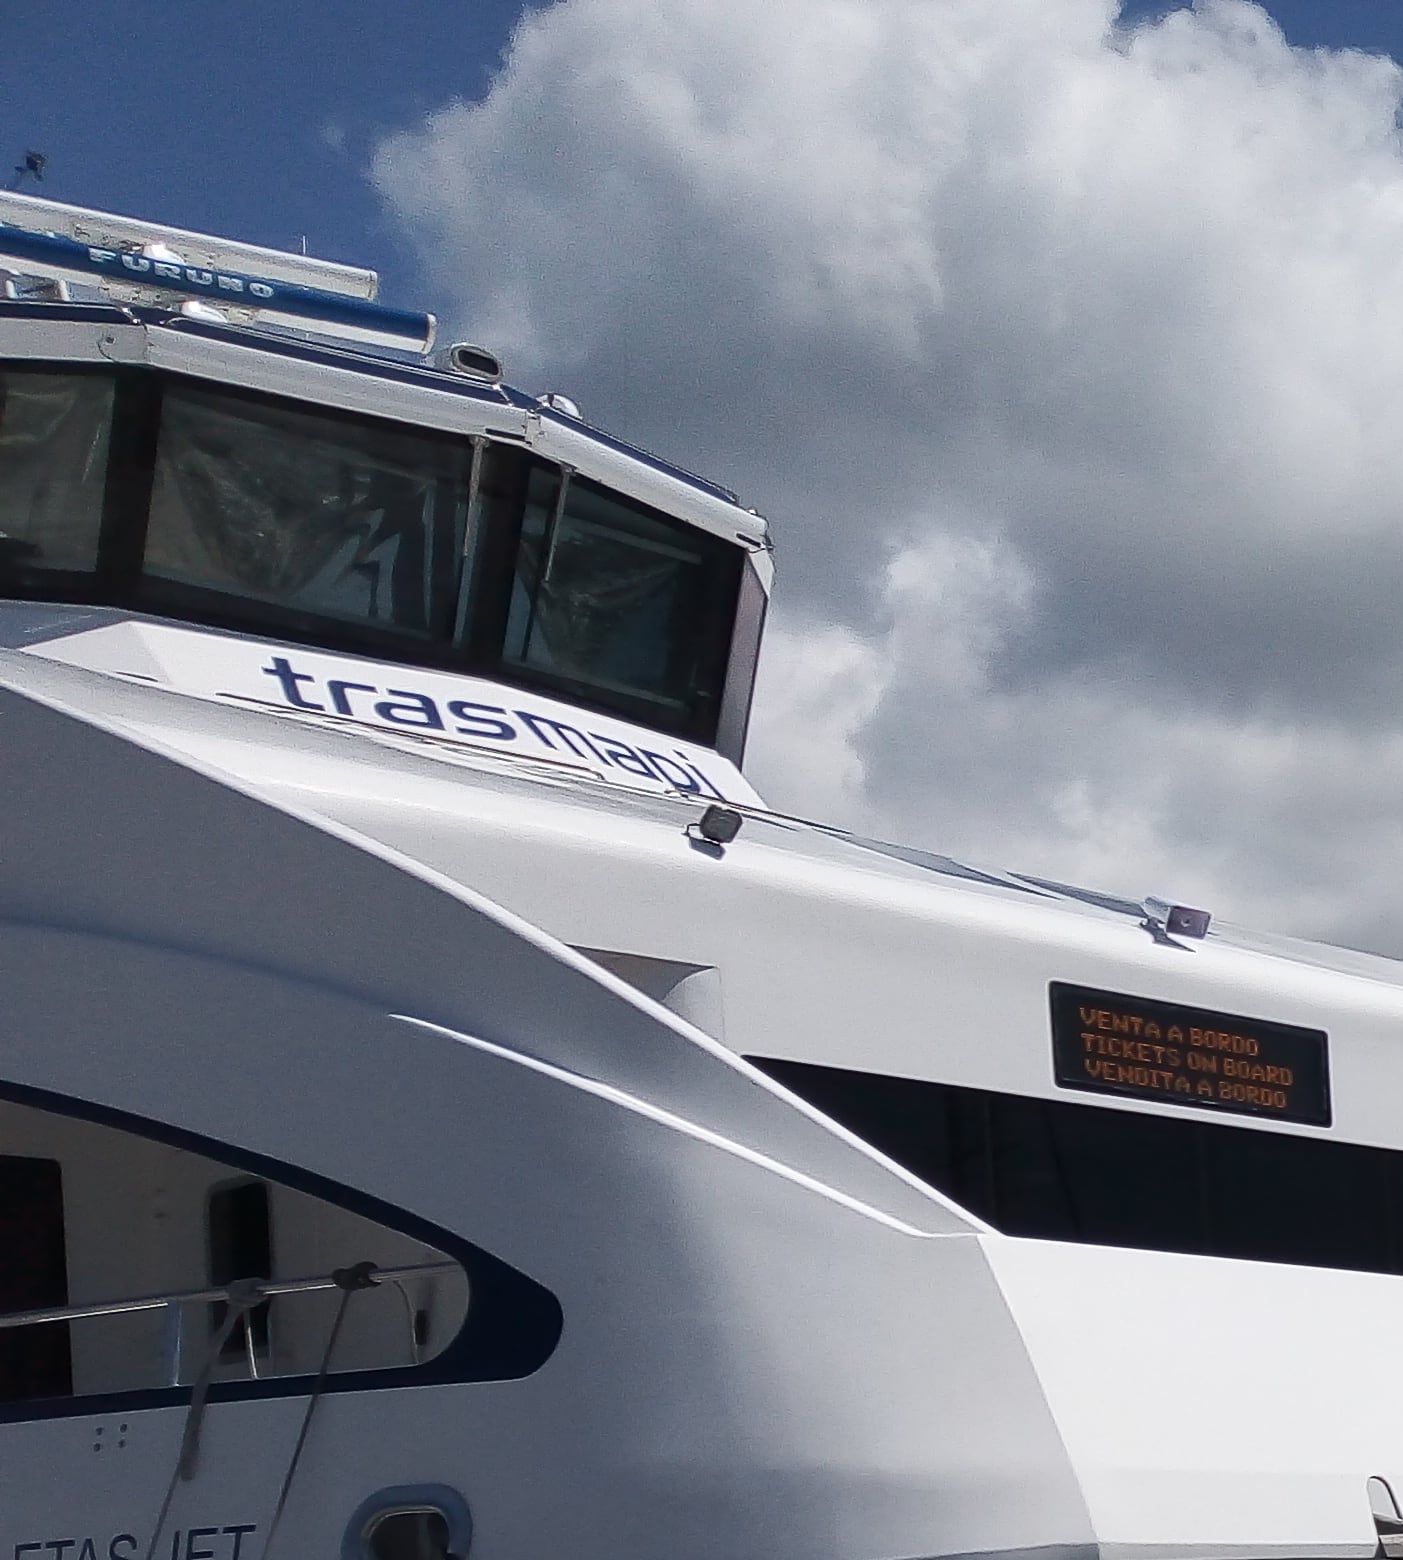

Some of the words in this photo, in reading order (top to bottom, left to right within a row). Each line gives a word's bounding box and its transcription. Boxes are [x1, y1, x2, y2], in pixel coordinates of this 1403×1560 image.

[87, 247, 274, 298] FURUNO
[261, 655, 726, 801] trasmapi
[1080, 1007, 1160, 1039] VENTA
[1167, 1025, 1183, 1042] A
[1188, 1027, 1260, 1056] BORDO
[1081, 1033, 1181, 1067] TICKETS
[1187, 1051, 1217, 1074] ON
[1223, 1058, 1294, 1087] BOARD
[1084, 1059, 1190, 1094] VENDITA
[1197, 1080, 1213, 1097] A
[1219, 1081, 1288, 1109] BORDO
